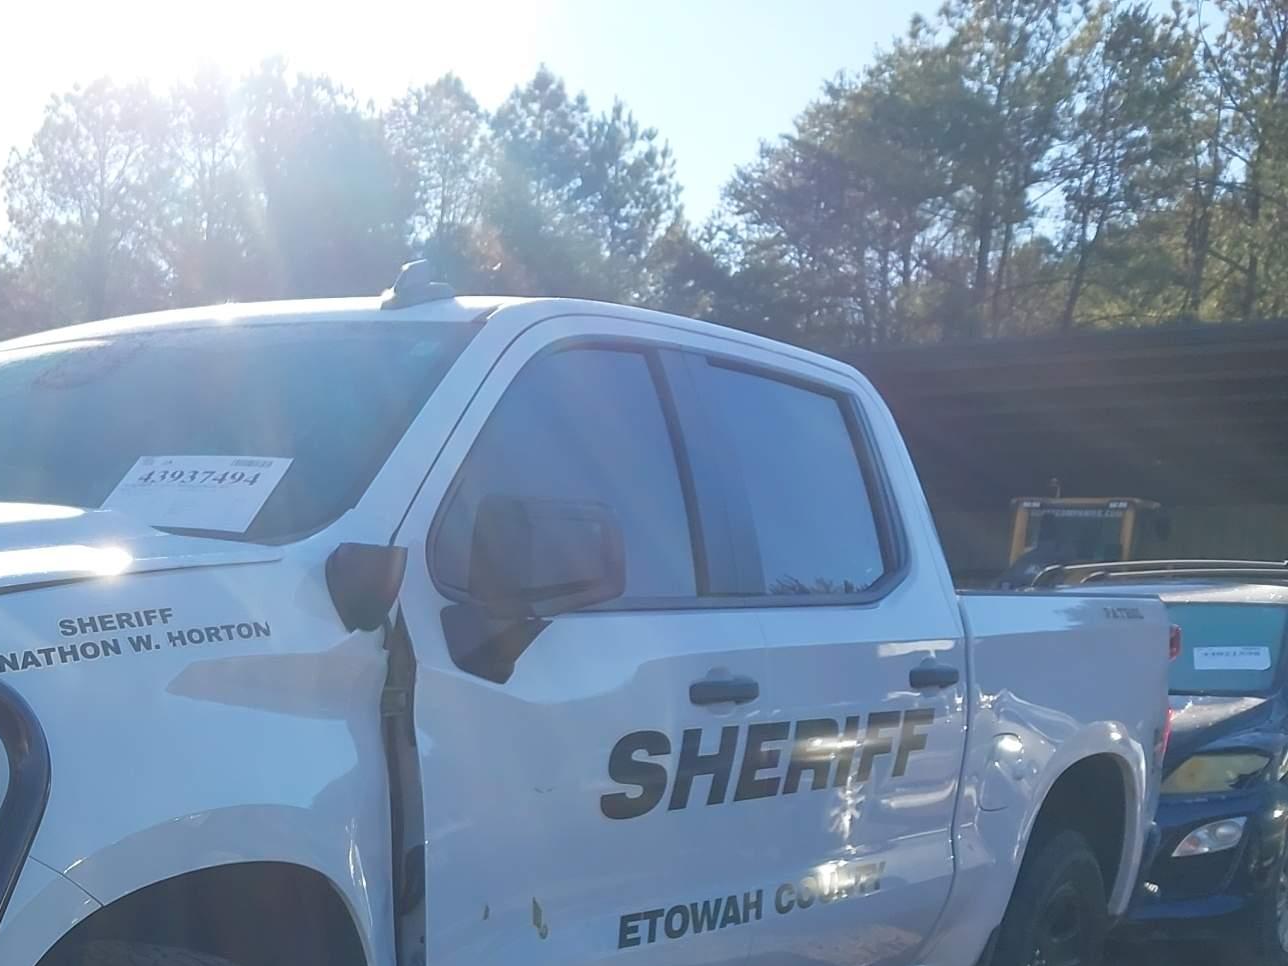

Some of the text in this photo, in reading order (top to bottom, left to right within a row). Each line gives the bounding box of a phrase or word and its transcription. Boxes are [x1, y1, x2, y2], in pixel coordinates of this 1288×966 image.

[139, 470, 262, 486] 43937494
[59, 607, 173, 637] SHERIFF
[127, 634, 161, 652] W.
[168, 621, 272, 648] HORTON
[600, 708, 935, 820] SHERIFF
[618, 861, 886, 949] ETOWAH COTY
